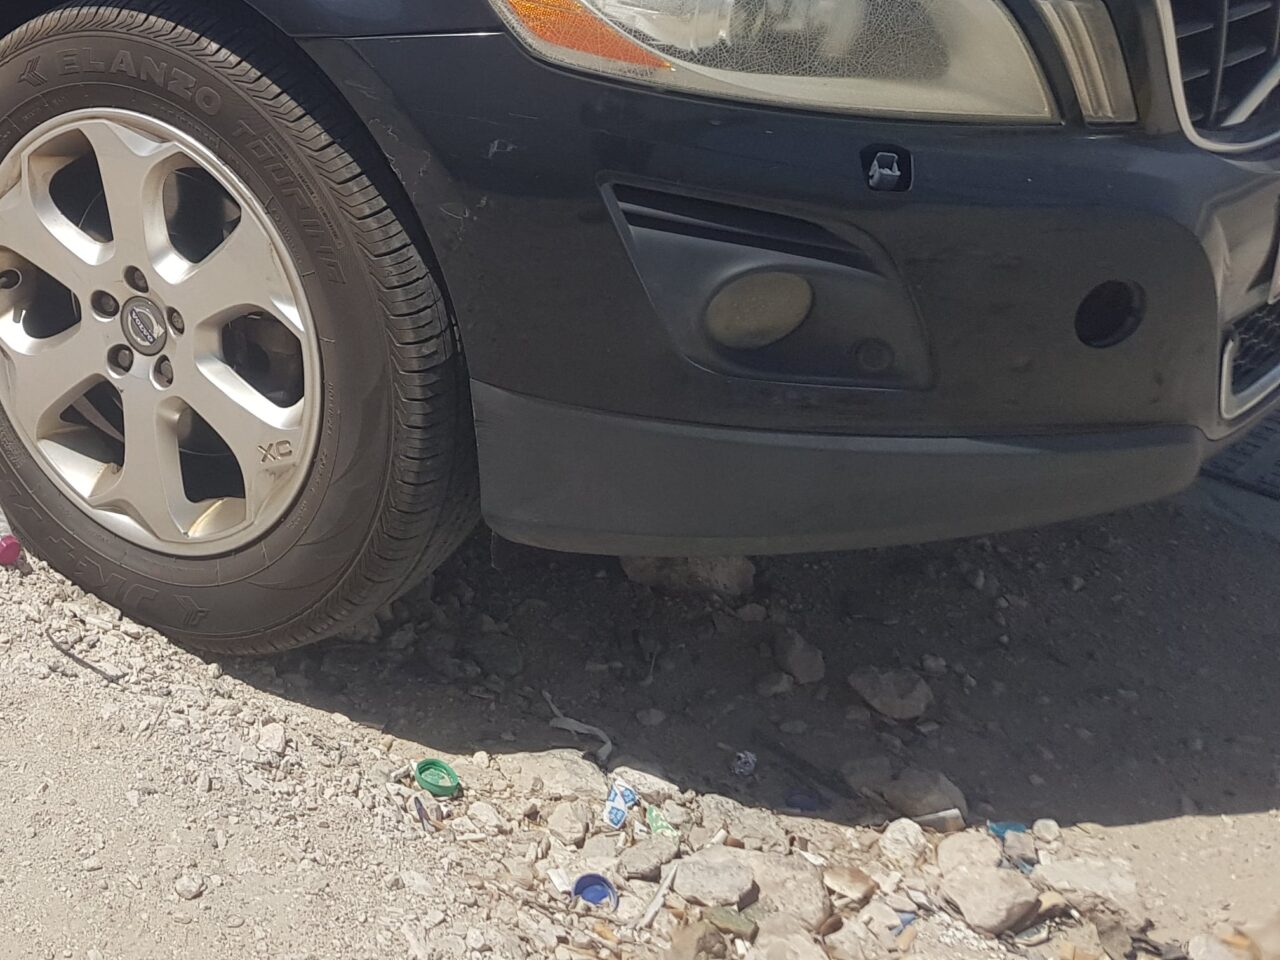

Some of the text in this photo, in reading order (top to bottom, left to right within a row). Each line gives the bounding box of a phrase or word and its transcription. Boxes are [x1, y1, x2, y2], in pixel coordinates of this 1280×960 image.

[56, 47, 221, 116] ELANZO
[131, 307, 155, 344] VOLVO
[257, 440, 293, 463] XC
